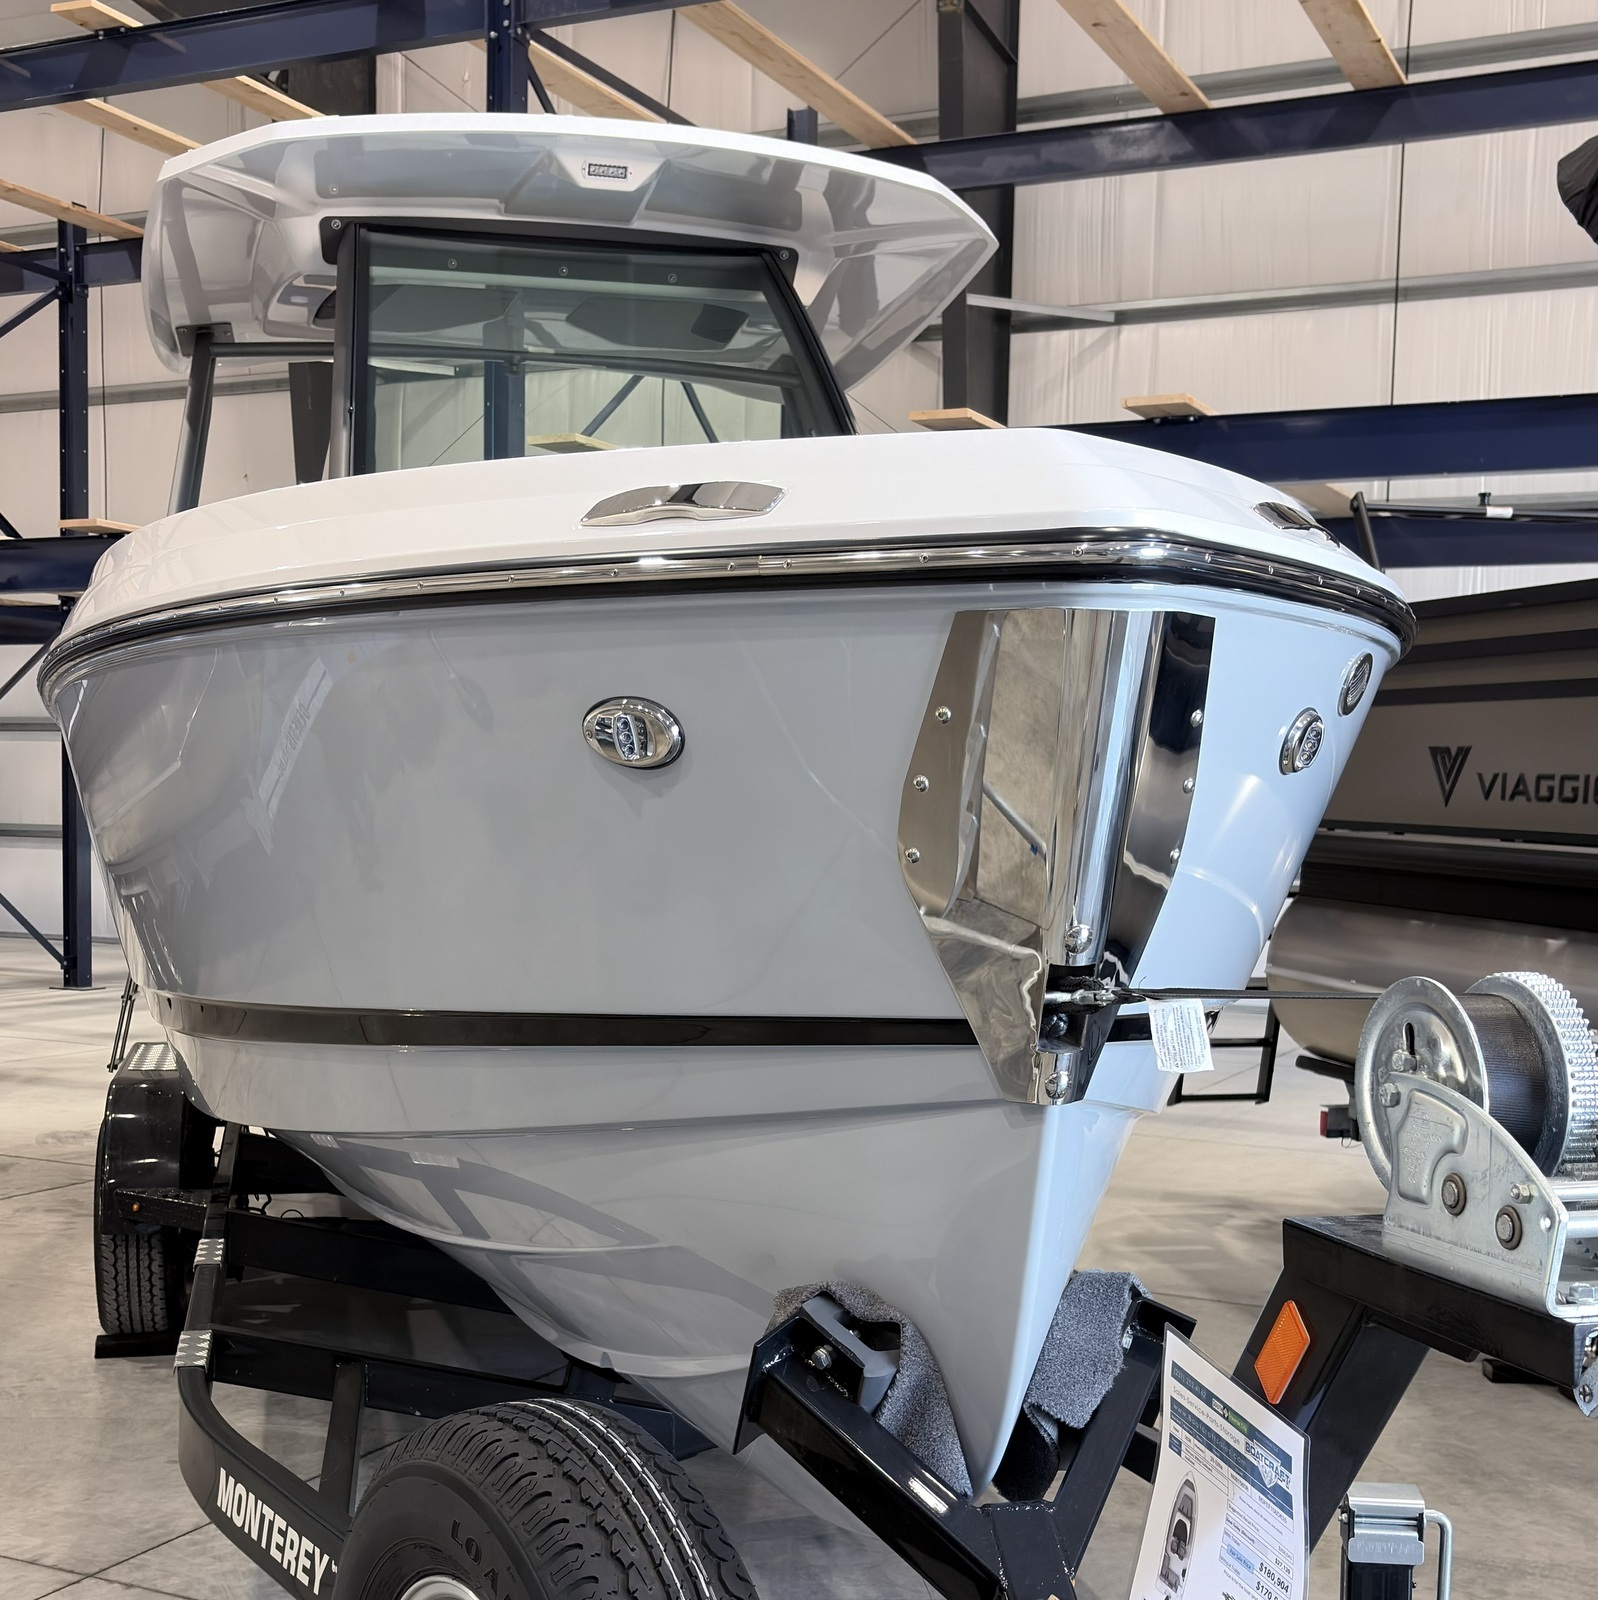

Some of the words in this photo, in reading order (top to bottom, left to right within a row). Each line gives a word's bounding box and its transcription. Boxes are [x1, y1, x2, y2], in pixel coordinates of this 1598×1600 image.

[1476, 771, 1598, 805] VIAGGI
[1245, 1441, 1290, 1488] BOATCRAFT
[216, 1466, 330, 1596] MONTEREY
[1258, 1562, 1289, 1594] $180,904
